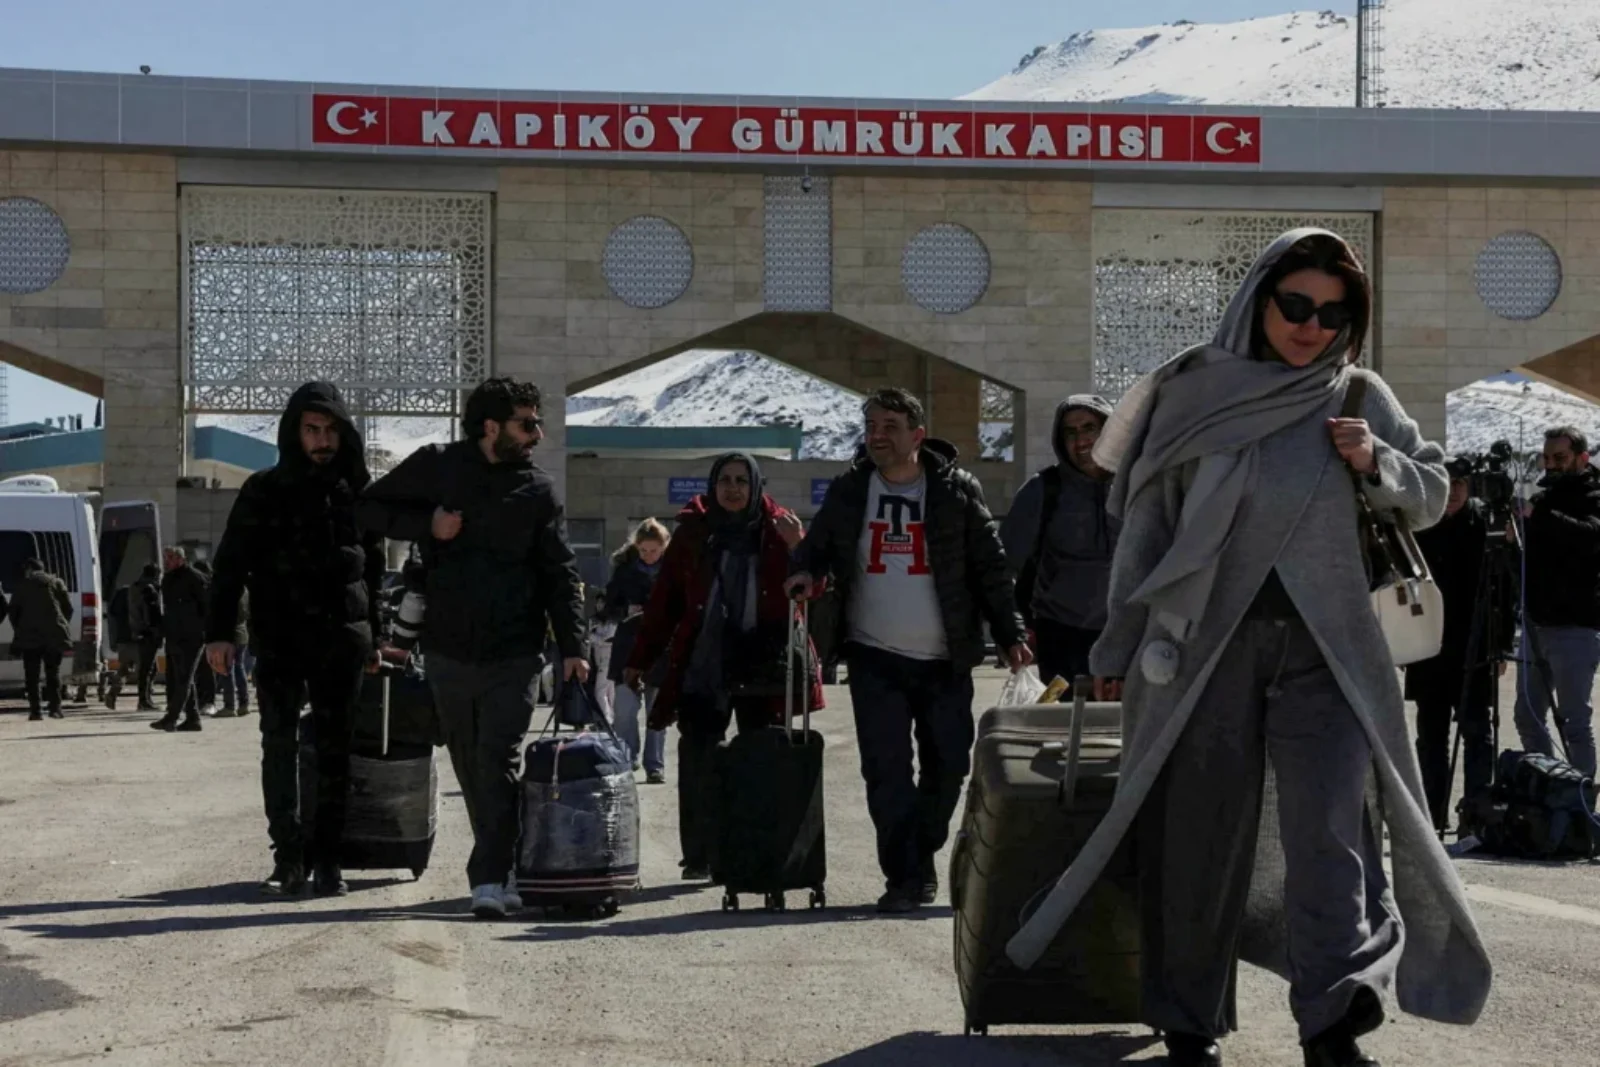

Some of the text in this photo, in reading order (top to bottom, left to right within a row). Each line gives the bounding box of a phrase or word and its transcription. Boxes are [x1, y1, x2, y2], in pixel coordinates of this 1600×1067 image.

[421, 105, 1164, 159] KAPIKÖY GÜMRÜK KAPISI
